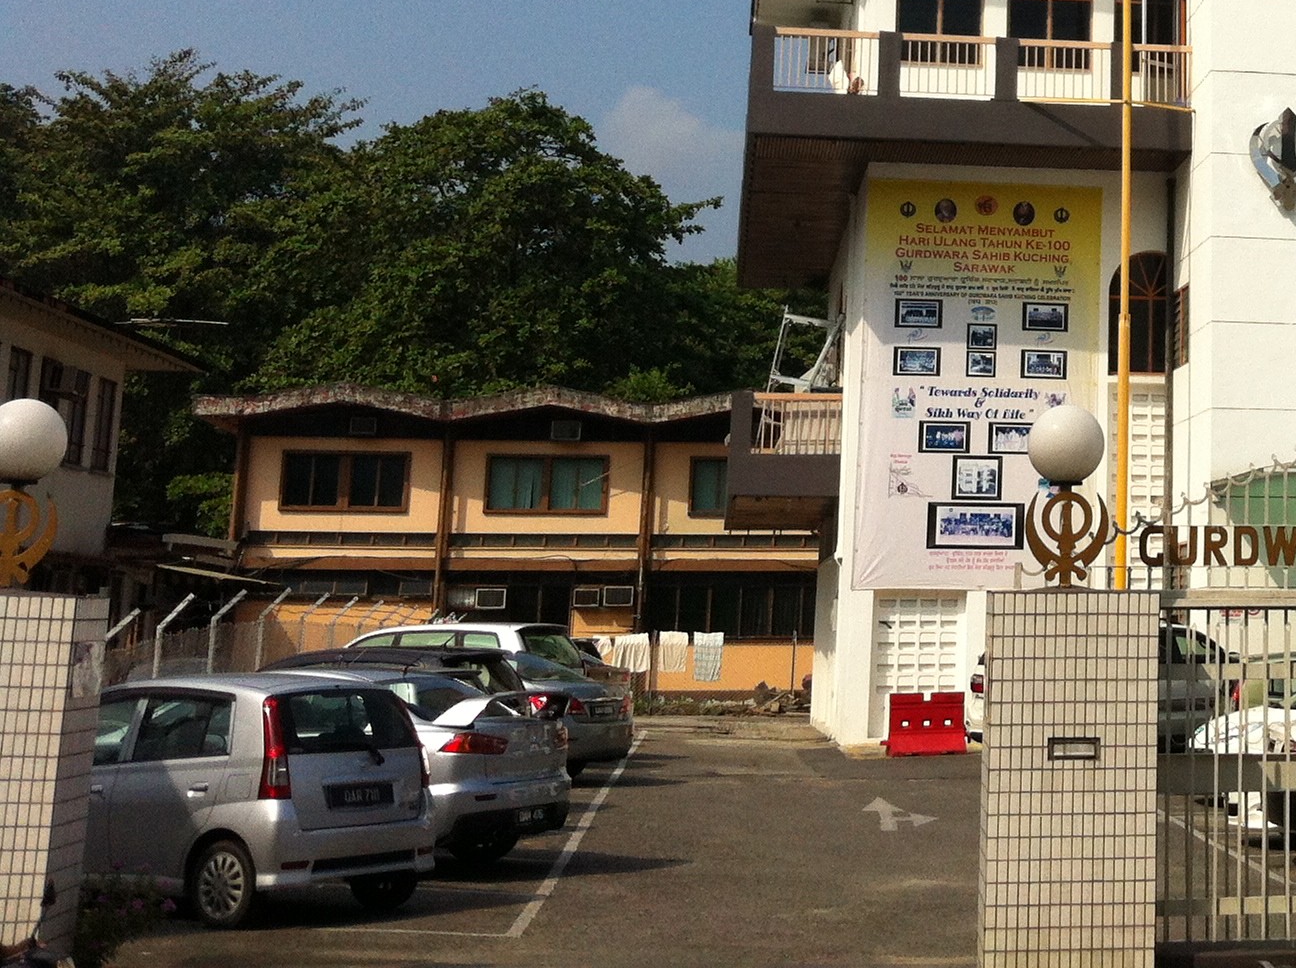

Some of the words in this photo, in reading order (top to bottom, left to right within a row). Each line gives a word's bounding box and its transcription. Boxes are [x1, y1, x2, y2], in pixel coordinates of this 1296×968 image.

[916, 223, 974, 235] SELAMAT
[977, 225, 1055, 238] MENYAMBUT
[899, 235, 930, 246] HARI
[933, 236, 977, 248] ULANG
[980, 238, 1023, 249] TAHUN
[1025, 240, 1071, 251] KE-100
[895, 247, 969, 260] GURDWARA
[972, 250, 1010, 261] SAHIB
[953, 261, 1016, 274] SARAWAK
[927, 386, 977, 398] Towards
[980, 387, 1041, 400] Solidarity
[925, 407, 953, 419] Sikh
[957, 408, 983, 420] Way
